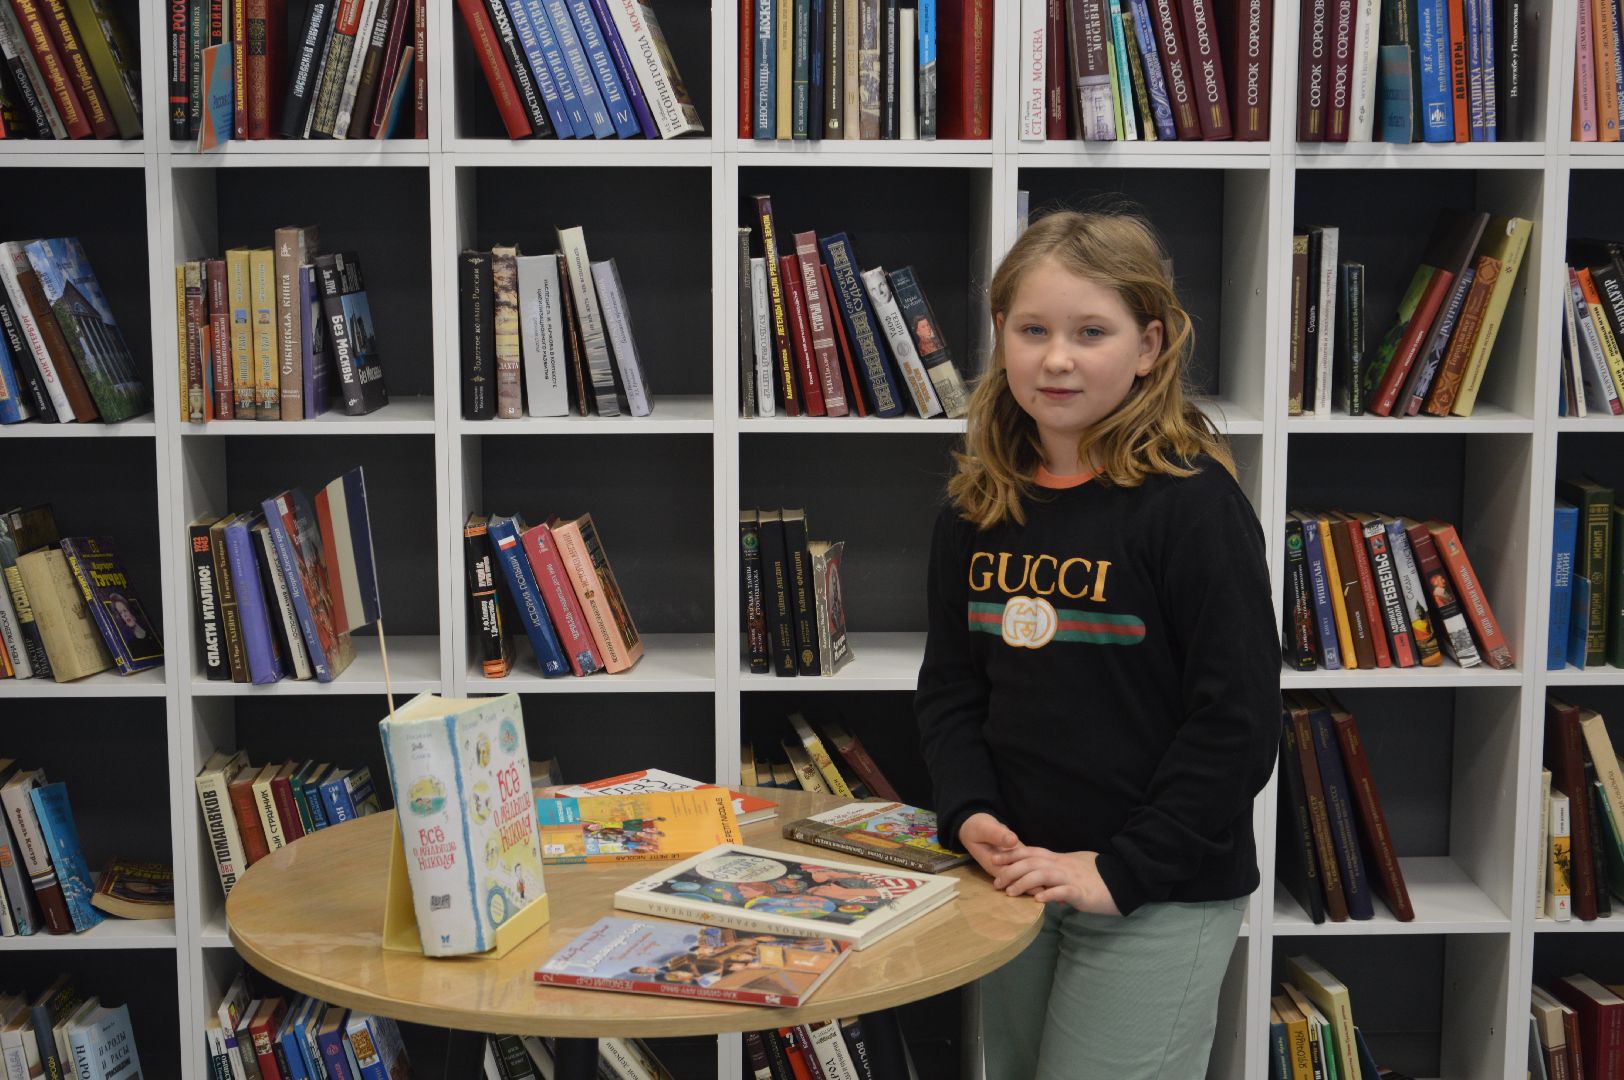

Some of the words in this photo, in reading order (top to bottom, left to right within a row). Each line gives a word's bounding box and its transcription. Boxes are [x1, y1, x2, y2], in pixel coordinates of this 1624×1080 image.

[29, 21, 49, 52] Жизнь
[56, 20, 78, 51] Жизнь
[192, 6, 200, 37] войнах
[509, 0, 536, 47] МОСКВЫ
[527, 0, 555, 47] МОСКВЫ
[549, 1, 576, 47] МОСКВЫ
[572, 1, 601, 49] МОСКВЫ
[1090, 3, 1102, 51] МОСКВЫ
[1248, 0, 1261, 56] СОРОКОВ
[1312, 0, 1325, 58] СОРОКОВ
[1337, 0, 1351, 58] СОРОКОВ
[1511, 3, 1519, 52] Подмосковья
[193, 62, 200, 72] на
[416, 31, 424, 62] МАНЕЖ
[638, 34, 662, 79] ГОРОДА
[1032, 28, 1042, 82] МОСКВА
[1084, 23, 1095, 70] ПЕРЕУЛКИ
[15, 68, 37, 106] ЧУРБАНОВ
[45, 54, 66, 91] Горбачев
[72, 53, 93, 90] Горбачев
[529, 50, 558, 102] ИСТОРИЯ
[547, 50, 576, 101] ИСТОРИЯ
[567, 48, 595, 96] ИСТОРИЯ
[593, 51, 622, 103] ИСТОРИЯ
[1170, 59, 1188, 103] СОРОК
[1202, 59, 1219, 102] СОРОК
[1247, 62, 1259, 106] СОРОК
[1310, 64, 1322, 107] СОРОК
[1334, 63, 1348, 108] СОРОК
[1454, 42, 1465, 100] АВИАТОРЫ
[1511, 86, 1518, 97] На
[60, 91, 79, 124] Михаил
[86, 90, 105, 124] Михаил
[192, 101, 200, 117] Мы
[653, 79, 682, 130] ИСТОРИЯ
[759, 63, 770, 128] ИНОСТРАНЦЫ
[1032, 88, 1042, 136] СТАРАЯ
[1471, 67, 1483, 128] БАЛАШИХА
[1484, 66, 1496, 127] БАЛАШИХА
[187, 299, 195, 318] ДОМ
[282, 274, 291, 307] книга
[770, 277, 780, 298] БЫЛИ
[836, 270, 854, 313] САМАРСКИЕ
[844, 267, 864, 311] СУДЬБЫ
[7, 327, 22, 352] ИДУТ
[331, 314, 345, 337] Без
[759, 314, 769, 367] КУЛЬТОВЫЙ
[774, 304, 785, 336] ЛЕГЕНДЫ
[884, 315, 897, 338] ФОРД
[891, 311, 905, 336] ГЕНРИ
[1307, 305, 1317, 333] Суздаль
[21, 312, 55, 383] САНКТ-ПЕТЕРБУРГ
[188, 320, 196, 381] ТОЛСТОВСКИЙ
[335, 338, 354, 384] Москвы
[273, 527, 284, 543] края
[1593, 530, 1603, 559] ИНДИЯ
[280, 543, 293, 571] Елецкого
[510, 555, 527, 590] ПОЛЬШИ
[774, 560, 784, 589] АНГЛИИ
[794, 551, 804, 586] ФРАНЦИИ
[969, 552, 1112, 602] GUCCI
[1562, 552, 1570, 587] ИНДИИ
[4, 565, 34, 622] МУССОЛИНИ
[198, 564, 216, 620] ИТАЛИЮ!
[288, 571, 302, 599] История
[799, 587, 807, 613] ТАЙНЫ
[1314, 559, 1327, 605] РИШЕЛЬЕ
[1376, 552, 1398, 606] ГЕББЕЛЬС
[522, 591, 541, 627] ИСТОРИЯ
[777, 590, 785, 617] ТАЙНЫ
[1387, 606, 1399, 633] АДВОКАТ
[1394, 604, 1407, 633] ДЬЯВОЛА
[0, 610, 17, 644] РЖЕВСКАЯ
[205, 621, 221, 667] СПАСТИ
[10, 644, 21, 665] ЕЛЕНА
[202, 789, 231, 865] ТОМАГАВКОВ
[260, 789, 278, 834] СТРАННИК
[714, 797, 726, 821] NICOLAS
[721, 820, 733, 838] PETIT
[15, 807, 28, 835] Фидель
[25, 838, 38, 865] Кастро
[615, 854, 646, 862] NICOLAS
[711, 913, 758, 929] ФРАНС
